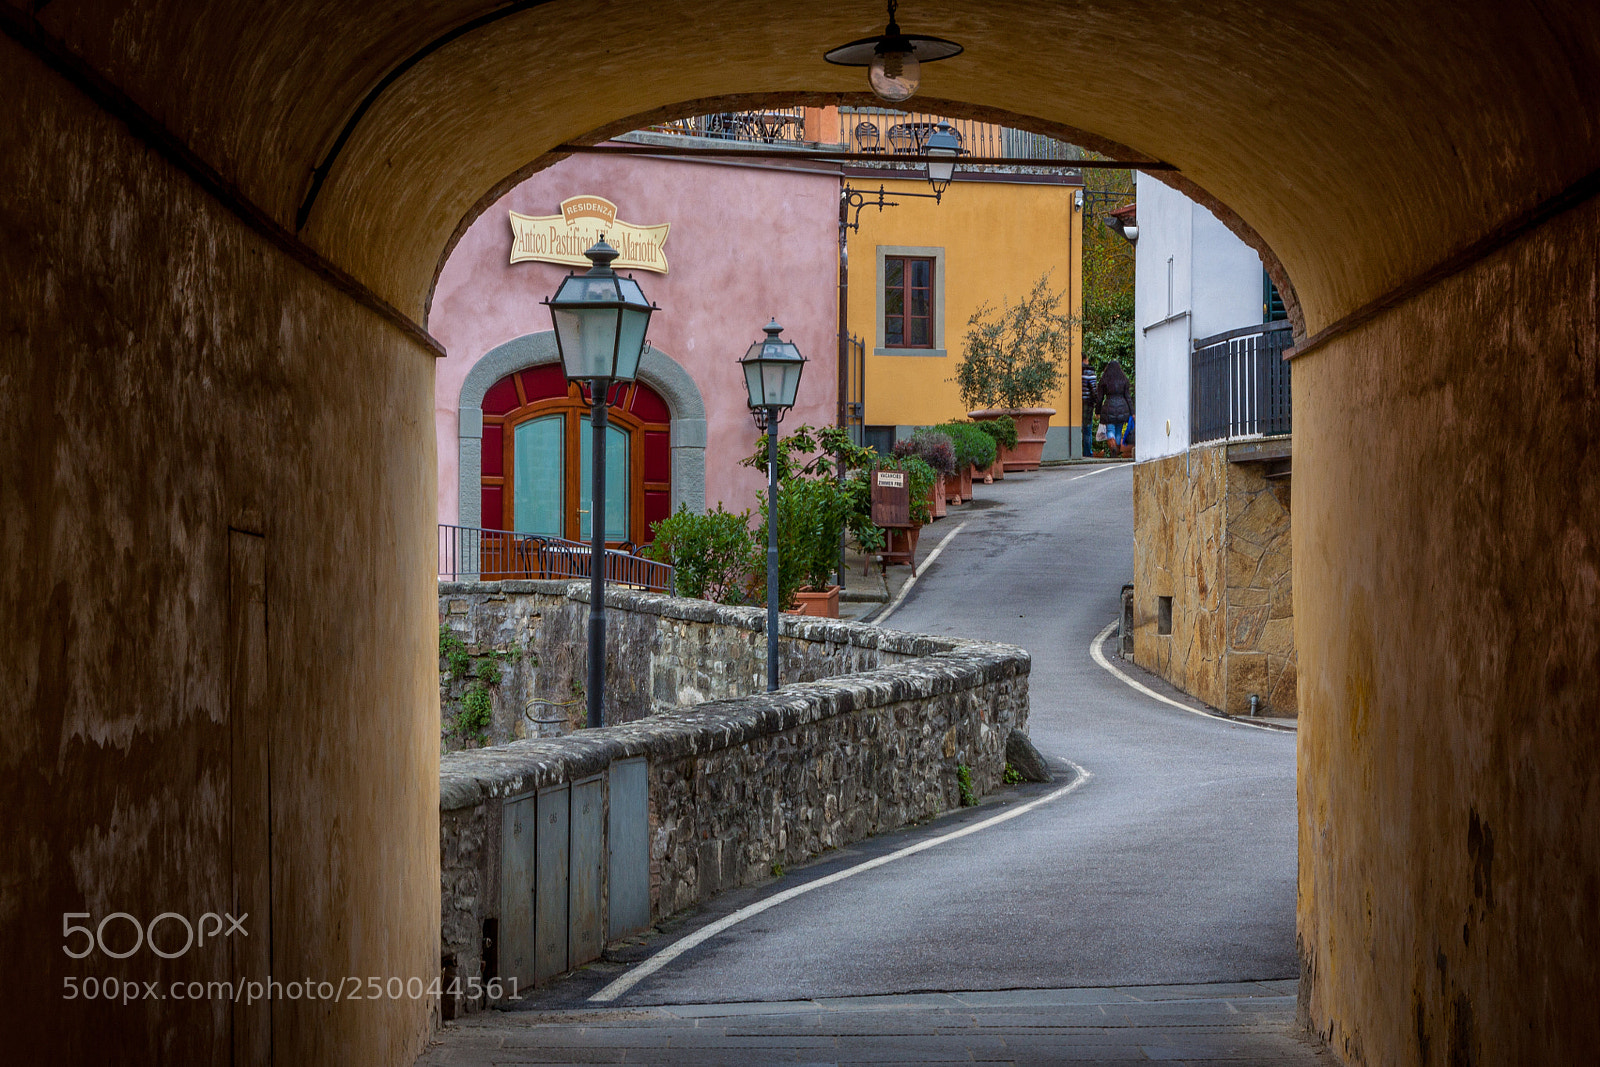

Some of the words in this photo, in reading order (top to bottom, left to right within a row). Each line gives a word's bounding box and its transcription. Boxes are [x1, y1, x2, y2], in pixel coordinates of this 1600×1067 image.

[566, 202, 613, 218] RESIDENZA
[518, 221, 547, 255] Antico
[622, 231, 657, 263] Mariotti
